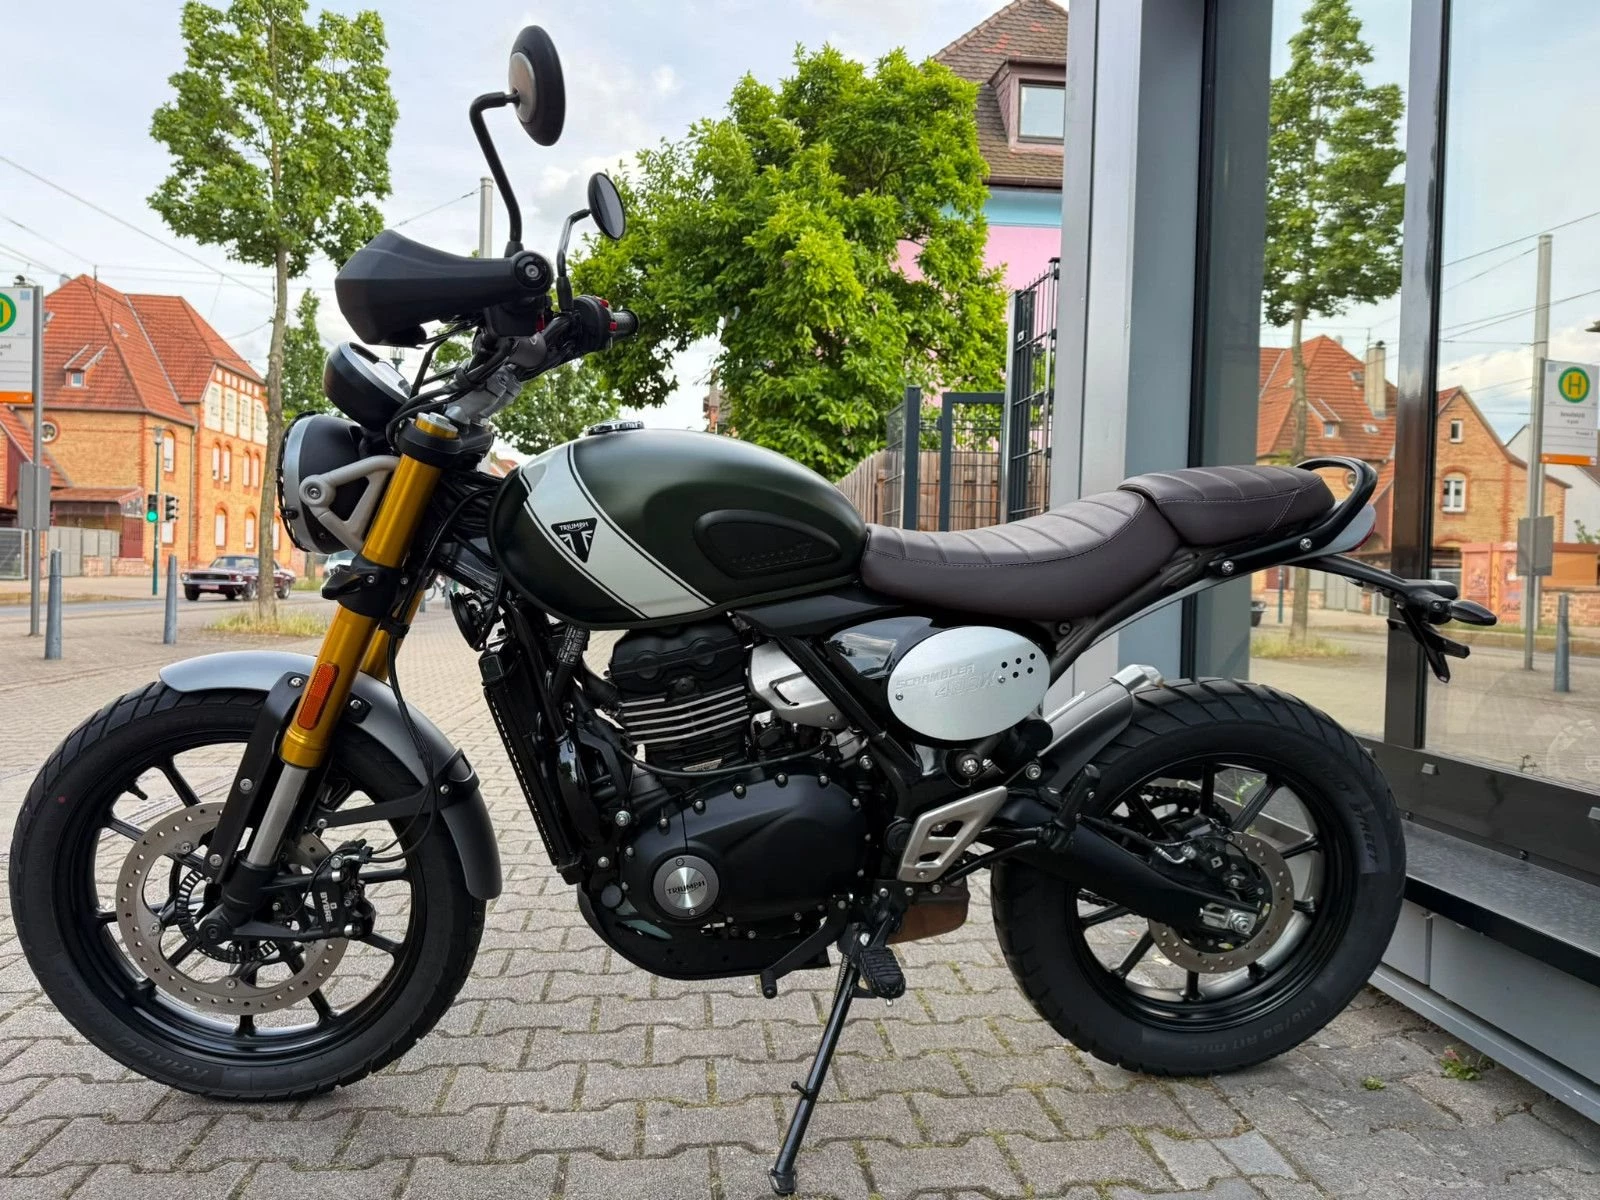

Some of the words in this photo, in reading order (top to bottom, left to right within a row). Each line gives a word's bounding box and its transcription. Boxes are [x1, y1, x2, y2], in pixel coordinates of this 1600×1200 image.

[559, 522, 589, 532] TRIUMPH
[895, 663, 975, 689] SCRAMBLER
[666, 880, 705, 895] TRIUMPH
[319, 891, 334, 923] BYBRE
[115, 1035, 209, 1080] KAROO
